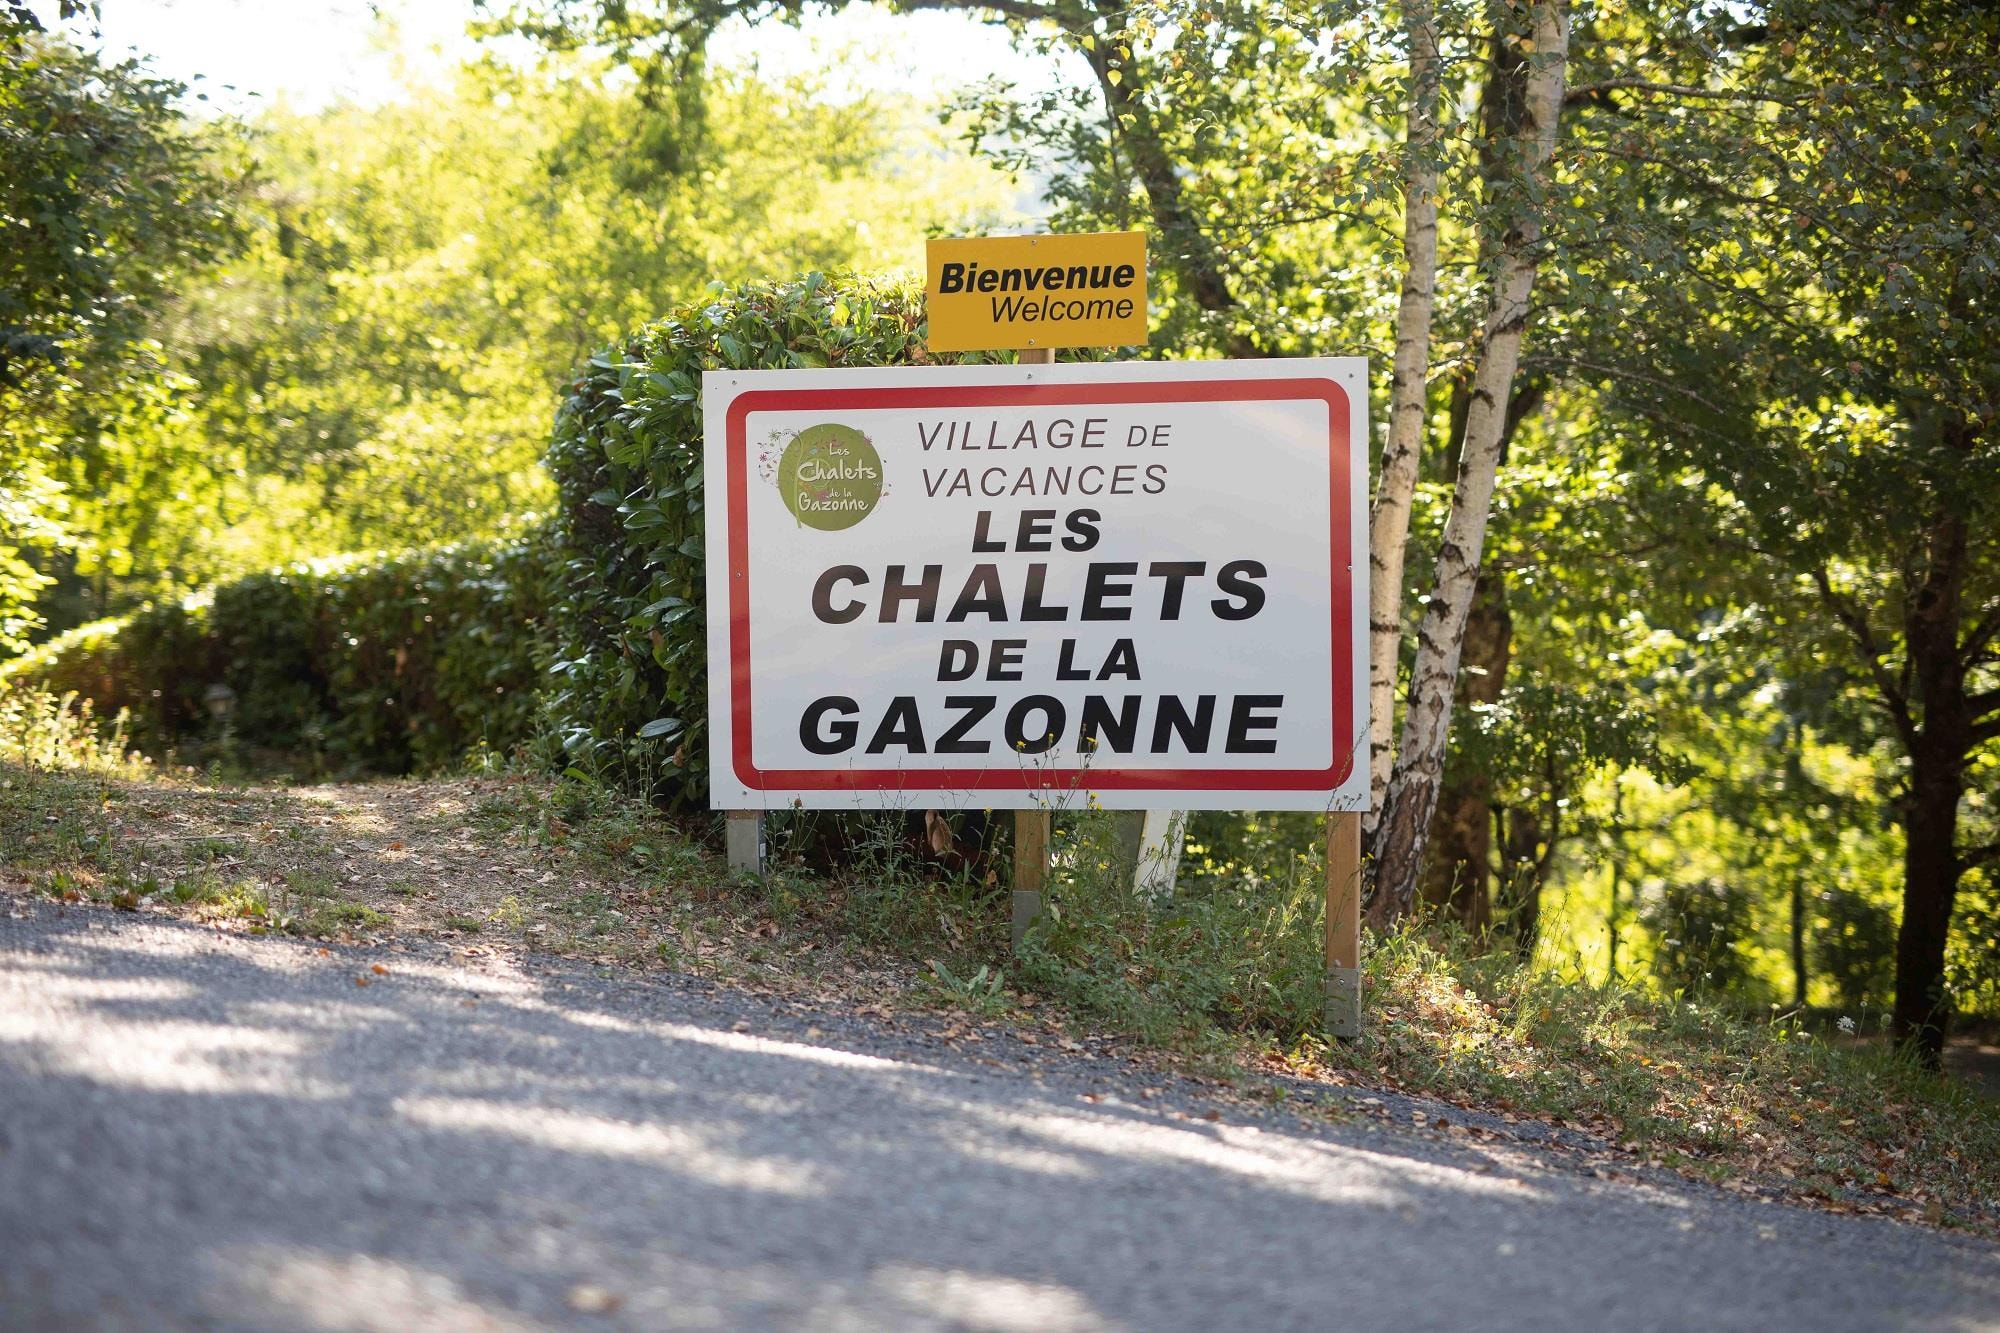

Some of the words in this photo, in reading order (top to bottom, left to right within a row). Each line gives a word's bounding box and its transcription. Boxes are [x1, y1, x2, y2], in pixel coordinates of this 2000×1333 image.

[940, 263, 1134, 293] Bienvenue
[991, 295, 1133, 322] Welcome
[829, 443, 850, 456] Les
[918, 419, 1108, 450] VILLAGE
[1127, 425, 1171, 447] DE
[798, 459, 877, 482] Chalets
[923, 465, 1167, 497] VACANCES
[799, 492, 869, 512] Gazonne
[829, 488, 840, 498] de
[843, 488, 852, 498] la
[972, 509, 1101, 552] LES
[812, 560, 1267, 624] CHALETS
[937, 639, 1027, 681] DE
[1056, 639, 1141, 680] LA
[800, 695, 1283, 754] GAZONNE
